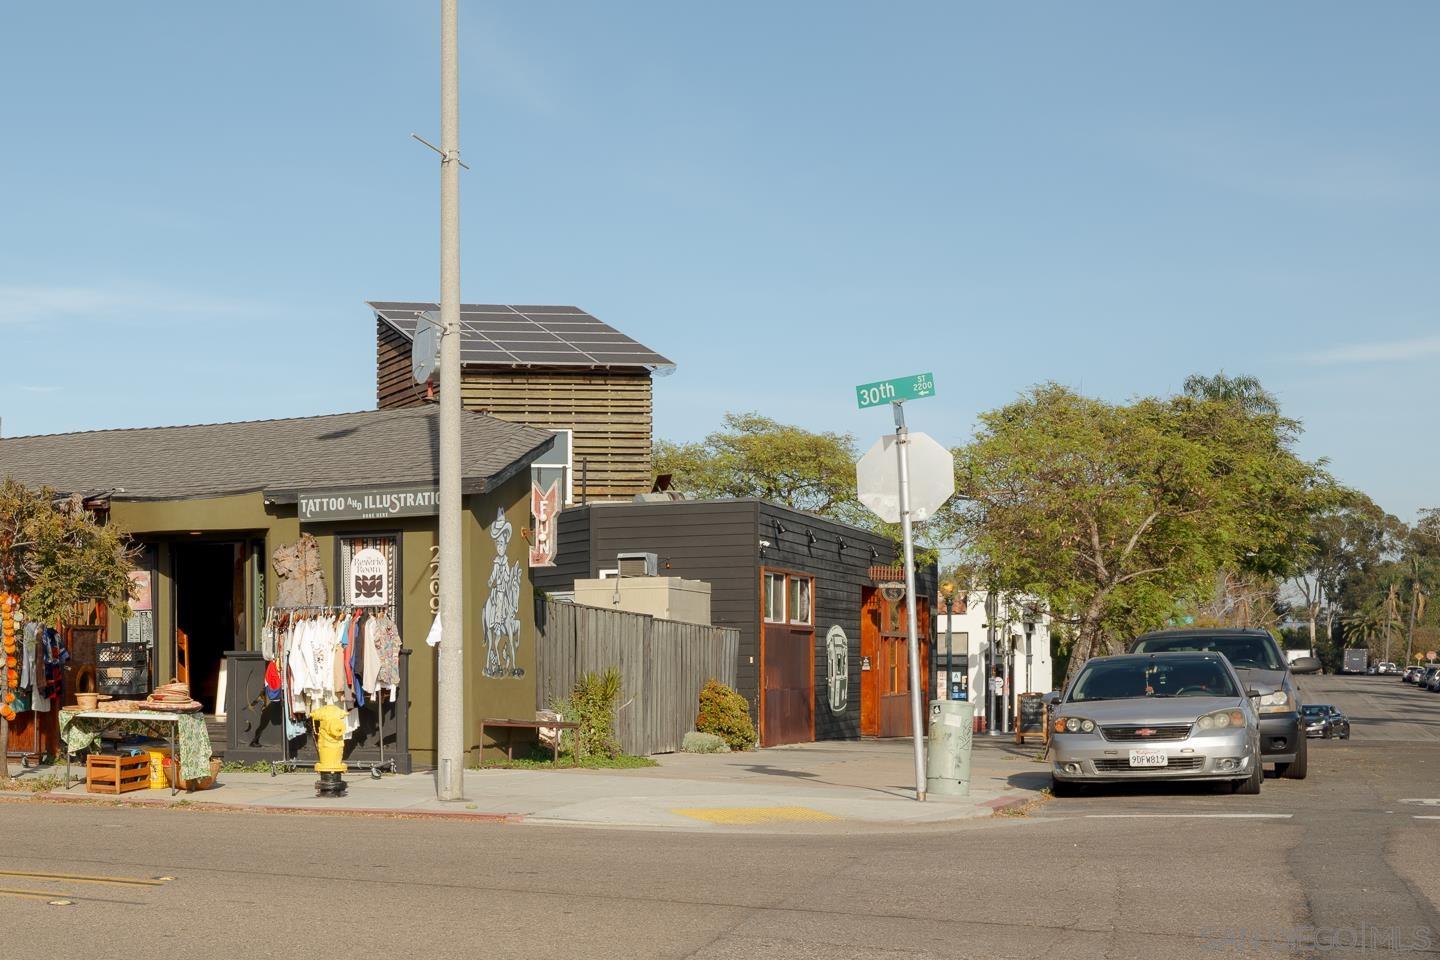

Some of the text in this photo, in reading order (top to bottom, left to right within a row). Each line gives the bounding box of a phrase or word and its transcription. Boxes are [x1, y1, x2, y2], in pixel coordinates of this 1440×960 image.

[860, 375, 926, 405] 30th ST
[913, 382, 933, 391] 2200
[301, 492, 440, 517] TATTOO AND ILLUSTRATIO
[354, 558, 384, 566] Reverie
[357, 566, 381, 574] Room
[1131, 755, 1165, 764] 9DFW819
